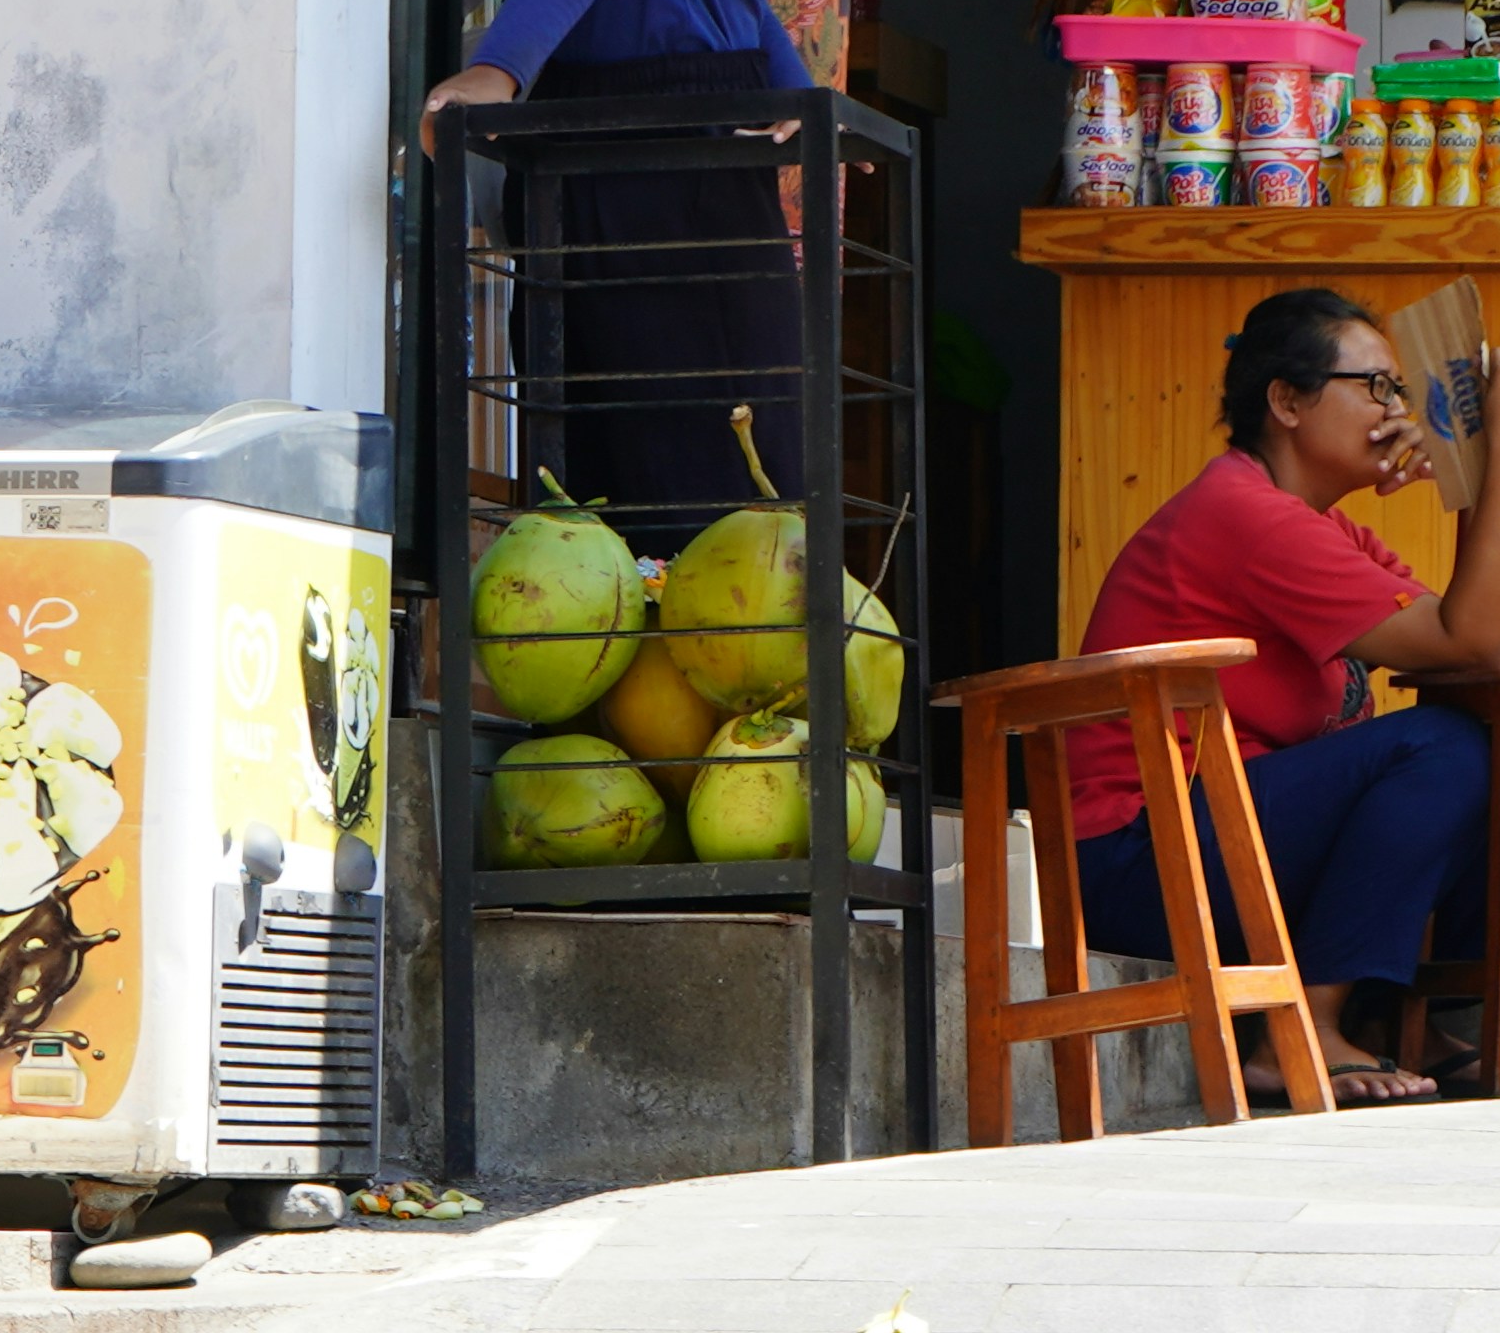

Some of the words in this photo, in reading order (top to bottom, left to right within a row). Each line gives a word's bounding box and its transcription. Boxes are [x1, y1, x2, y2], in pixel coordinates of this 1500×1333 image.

[1078, 160, 1136, 173] Sedaap
[1169, 170, 1203, 191] POP
[1257, 170, 1291, 192] POP
[1174, 186, 1210, 205] MIE
[1263, 185, 1298, 204] MIE
[1445, 357, 1484, 439] AQUA
